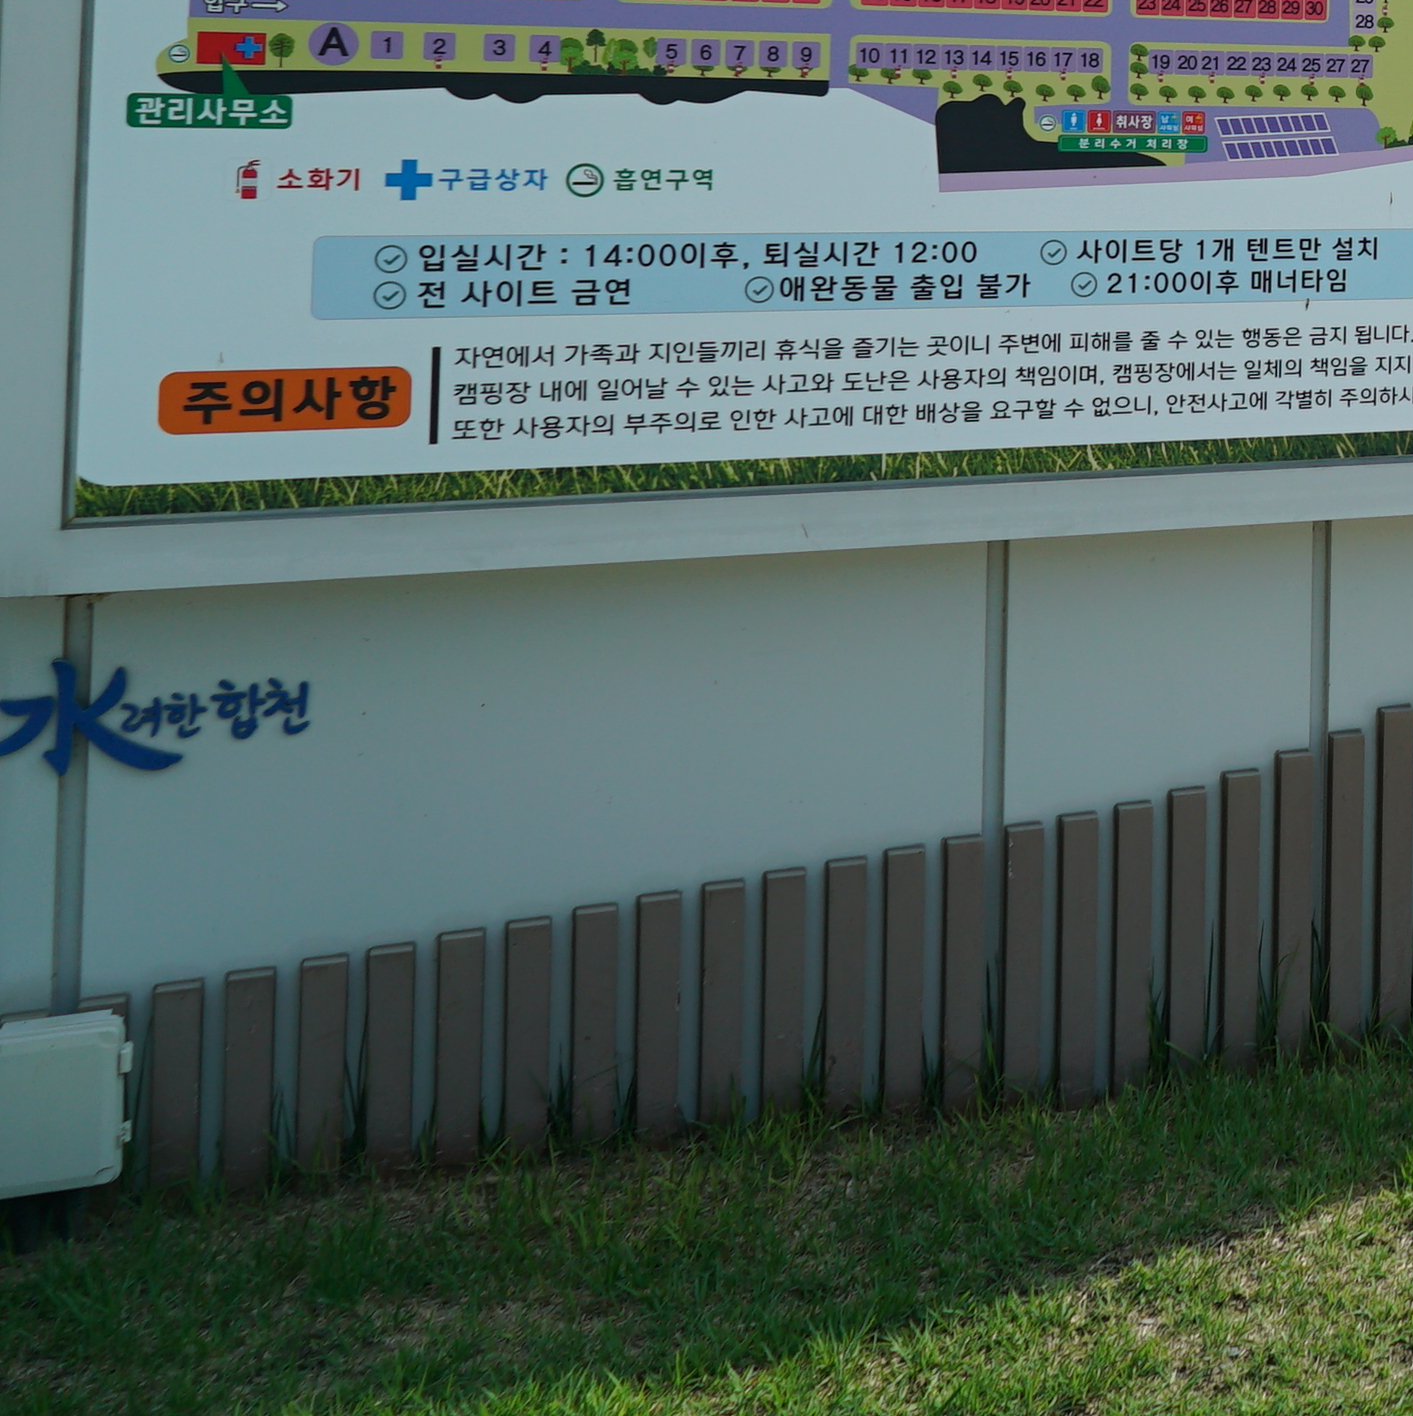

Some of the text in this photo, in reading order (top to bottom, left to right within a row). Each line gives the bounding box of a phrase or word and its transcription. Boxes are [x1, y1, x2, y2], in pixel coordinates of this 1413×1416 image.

[1355, 14, 1375, 29] 28
[317, 26, 813, 63] A 1 2 3 4 5 6 7 8 9
[134, 96, 289, 126] 관리사무소
[1115, 114, 1153, 130] 취사장
[276, 167, 361, 192] 소화기
[438, 168, 549, 192] 구급상자
[613, 168, 714, 192] 흡연구역
[417, 244, 548, 272] 입실시간
[763, 240, 880, 268] 퇴실시간
[894, 240, 978, 264] 12:00
[1077, 236, 1378, 264] 사이트당 1개 텐트만 설치
[416, 278, 631, 309] 전 사이트 금연
[780, 272, 1032, 303] 애완동물 출입 불가
[1106, 269, 1348, 295] 21:00이후 매너타임
[454, 345, 556, 369] 자연에서
[563, 343, 641, 367] 가족과
[648, 339, 767, 364] 지인들끼리
[773, 338, 845, 362] 휴식을
[851, 336, 920, 360] 즐기는
[926, 334, 991, 357] 곳이니
[998, 332, 1062, 355] 주변에
[1068, 330, 1134, 353] 피해를
[1139, 330, 1161, 351] 줄
[1167, 329, 1189, 351] 수
[1195, 328, 1235, 350] 있는
[1241, 327, 1303, 349] 행동은
[1308, 326, 1347, 347] 금지
[453, 381, 533, 405] 캠핑장
[539, 379, 588, 403] 내에
[596, 377, 669, 401] 일어날
[675, 376, 701, 399] 수
[707, 374, 755, 398] 있는
[762, 372, 834, 396] 사고와
[841, 370, 911, 394] 도난은
[917, 367, 1007, 391] 사용자의
[1014, 364, 1105, 388] 책임이며,
[1112, 360, 1238, 384] 캠핑장에서는
[1243, 358, 1303, 381] 일체의
[1309, 356, 1369, 378] 책임을
[1374, 354, 1412, 376] 지지
[183, 375, 397, 425] 주의사항
[451, 416, 505, 441] 또한
[512, 413, 615, 439] 사용자의
[622, 410, 723, 435] 부주의로
[729, 408, 778, 432] 인한
[784, 405, 854, 429] 사고에
[862, 403, 908, 426] 대한
[915, 400, 983, 424] 배상을
[990, 398, 1057, 421] 요구할
[1063, 397, 1085, 419] 수
[1091, 395, 1158, 418] 없으니,
[1165, 390, 1268, 415] 안전사고에
[1274, 388, 1333, 411] 각별히
[210, 677, 311, 740] 합천
